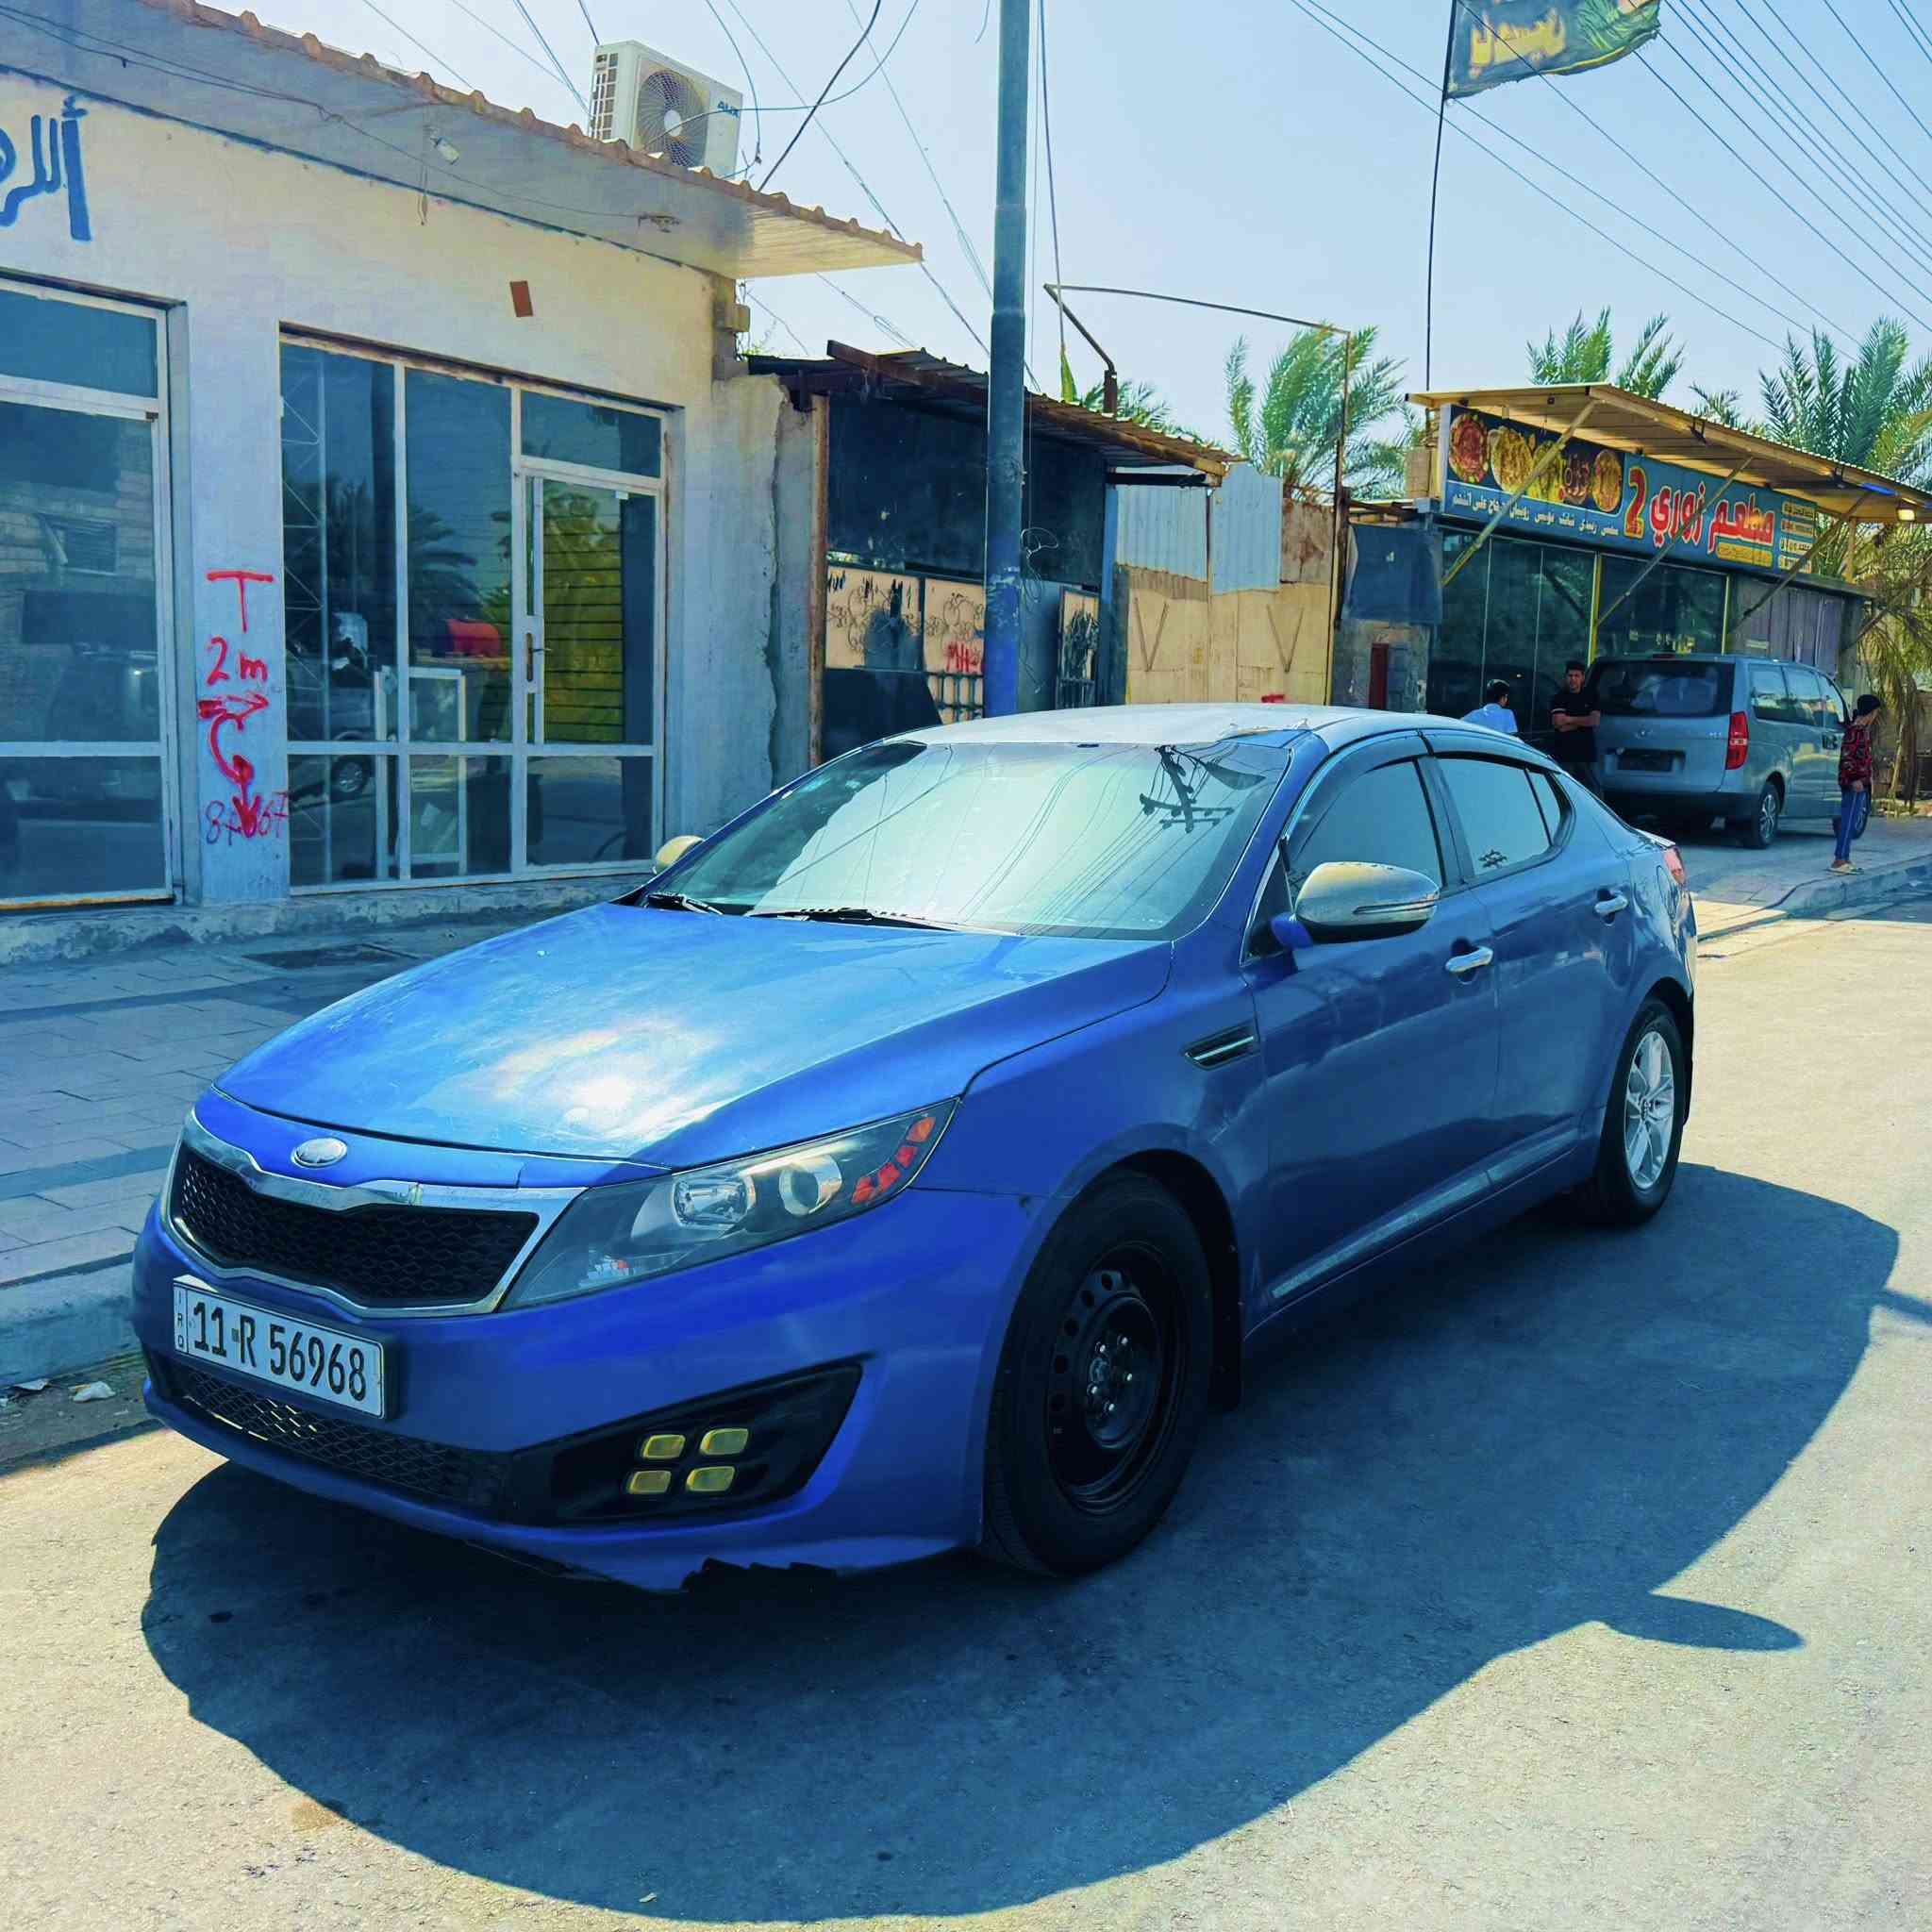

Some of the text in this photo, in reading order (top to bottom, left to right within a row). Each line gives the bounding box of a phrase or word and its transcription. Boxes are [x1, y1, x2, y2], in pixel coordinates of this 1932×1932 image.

[1624, 467, 1646, 540] 2
[1707, 491, 1775, 555] مطعم
[207, 570, 275, 633] T
[193, 1301, 367, 1402] 11 R 56968
